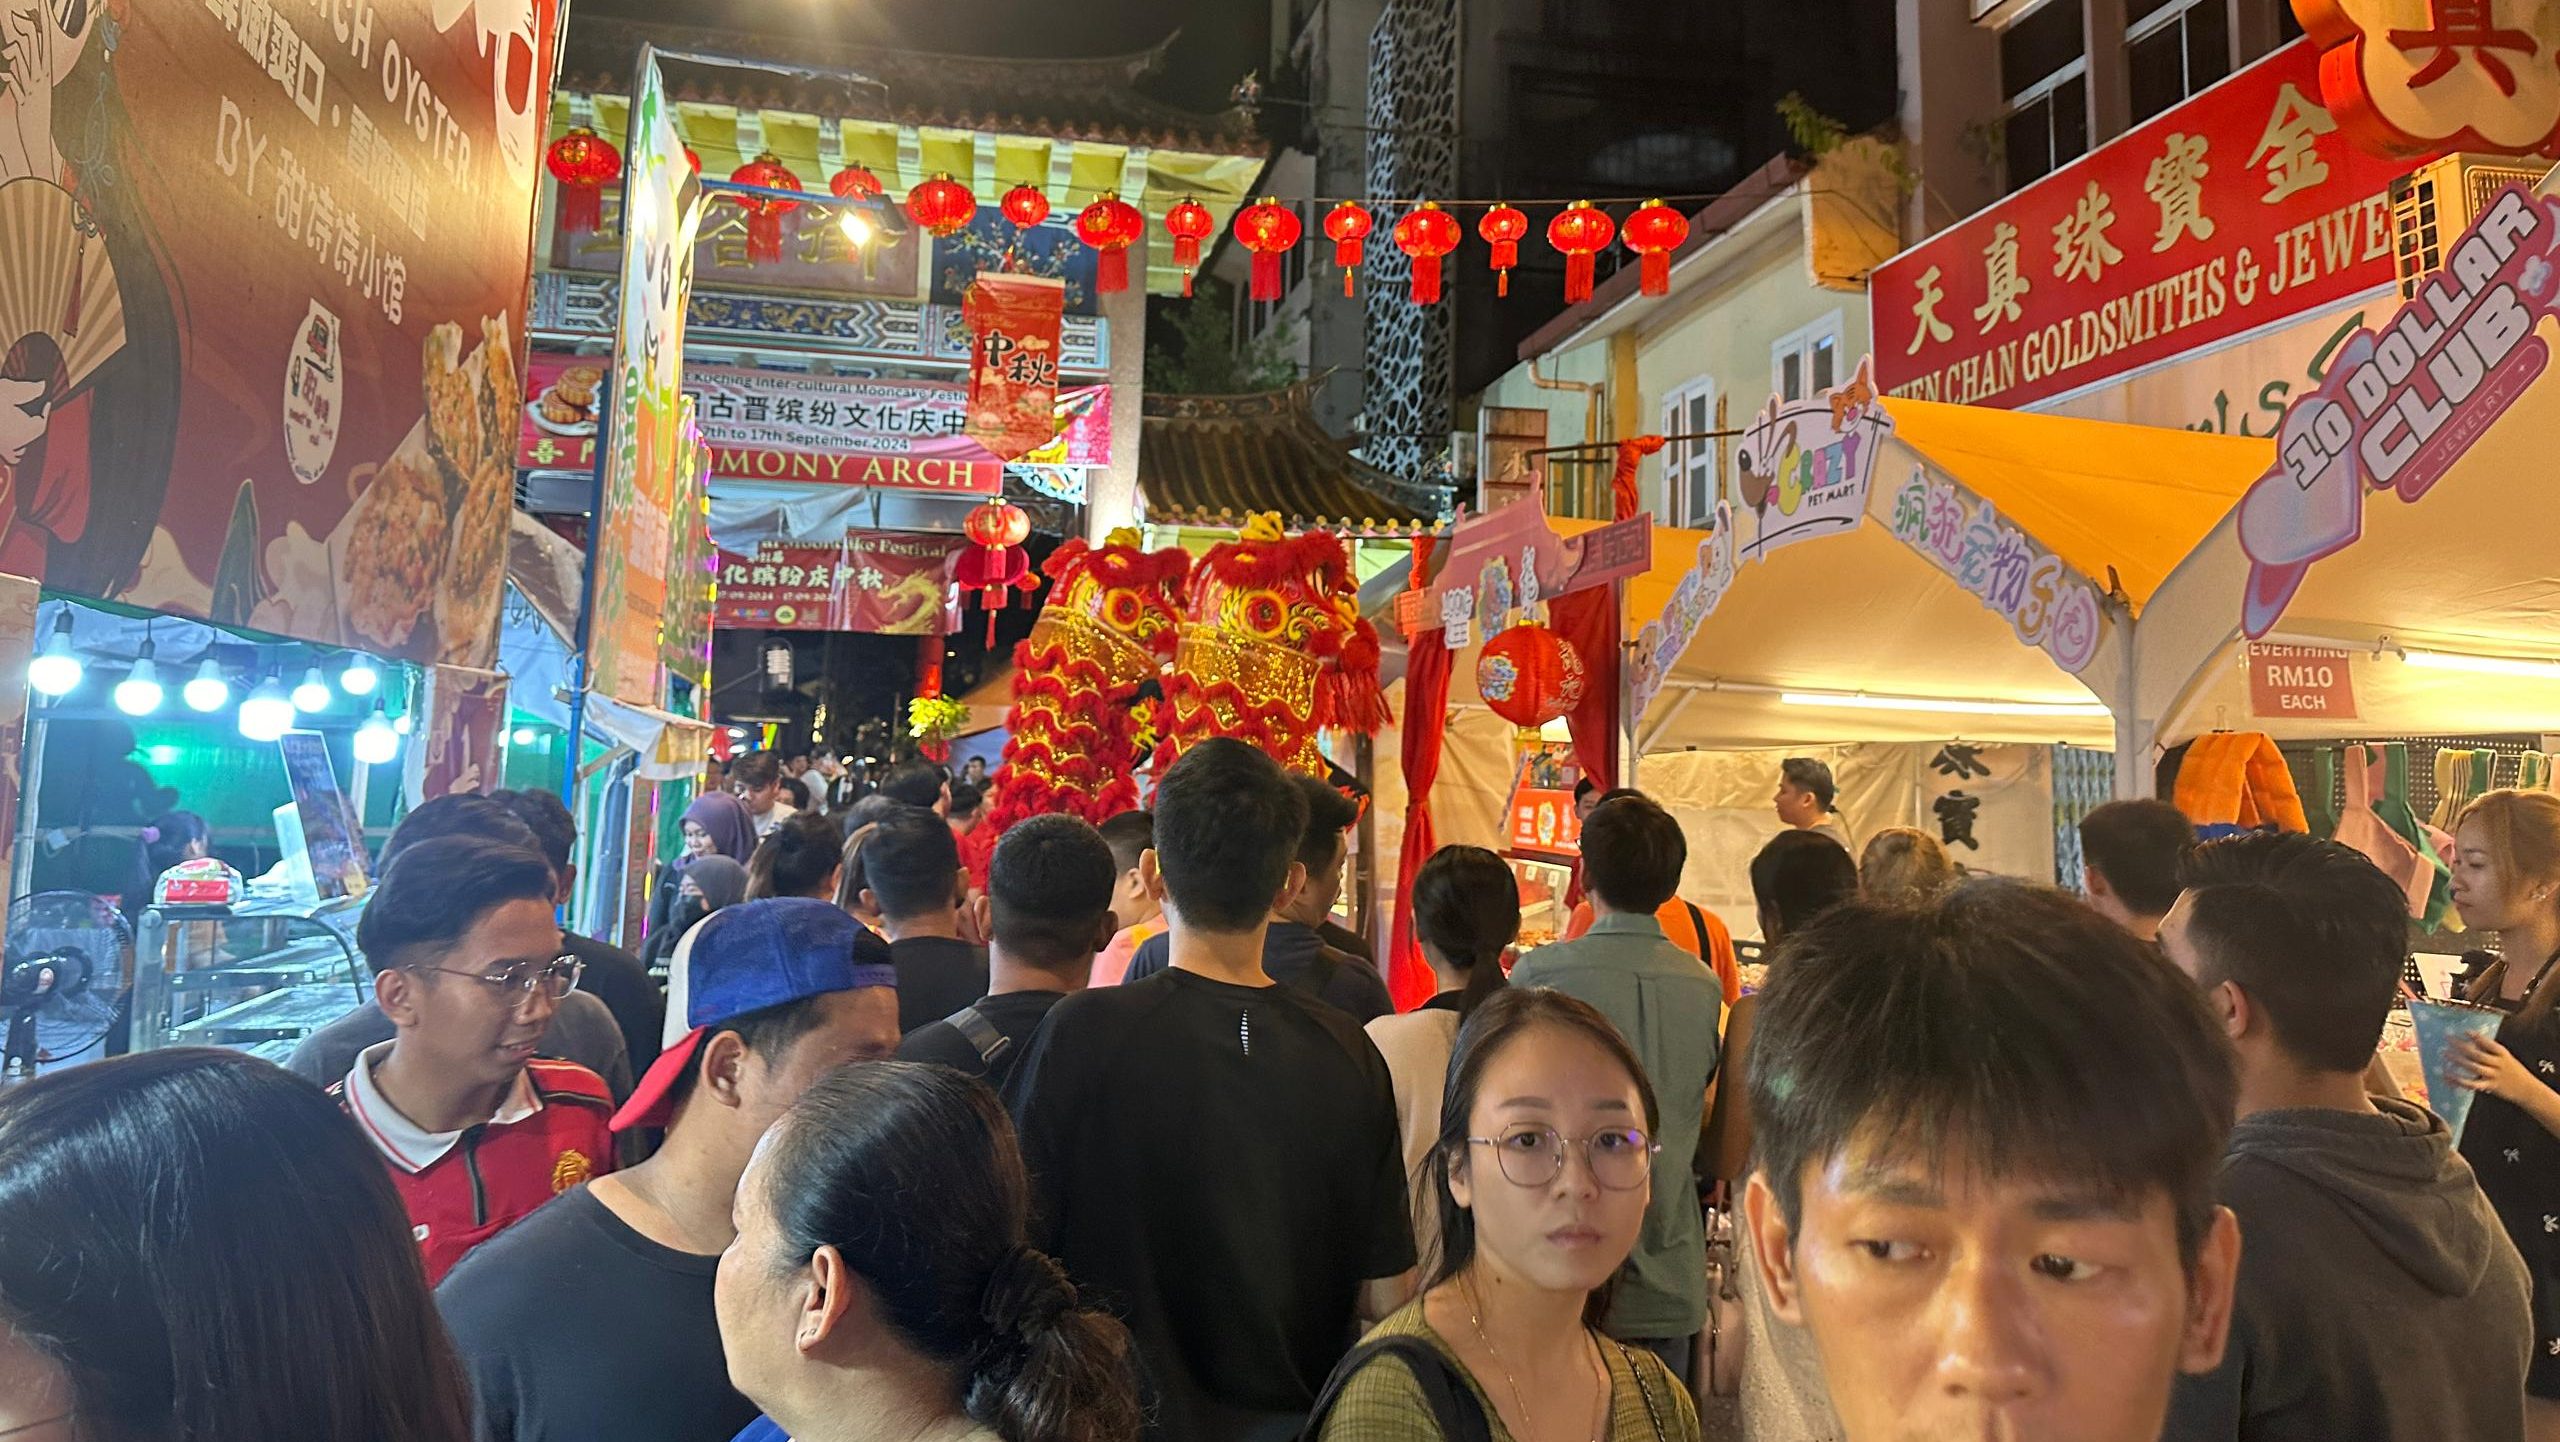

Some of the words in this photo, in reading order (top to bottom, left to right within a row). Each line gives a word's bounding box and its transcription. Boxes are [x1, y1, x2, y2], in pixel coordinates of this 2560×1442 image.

[382, 39, 471, 193] OYSTER
[215, 95, 267, 196] BY
[1945, 340, 2019, 405] CHAN
[2022, 255, 2228, 383] GOLDSMITHS
[2233, 247, 2260, 306] &
[2269, 190, 2393, 295] JEWE
[983, 330, 1056, 387] 中秋
[2284, 400, 2354, 491] 10
[2346, 189, 2539, 419] DOLLAR
[756, 376, 852, 394] Inter-cultural
[856, 384, 926, 399] Mooncake
[930, 389, 968, 401] Festiv
[2360, 283, 2531, 482] CLUB
[731, 428, 746, 439] to
[751, 428, 782, 441] 17th
[786, 431, 867, 448] September
[872, 437, 908, 450] 2024
[2436, 386, 2506, 461] JEWELRY
[718, 448, 849, 481] MONY
[862, 456, 974, 488] ARCH
[1777, 431, 1861, 516] CRAZY
[1808, 493, 1824, 507] PET
[1826, 484, 1855, 502] MART
[716, 563, 884, 590] 化缤纷庆中秋
[2267, 665, 2334, 688] RM10
[2280, 695, 2327, 710] EACH
